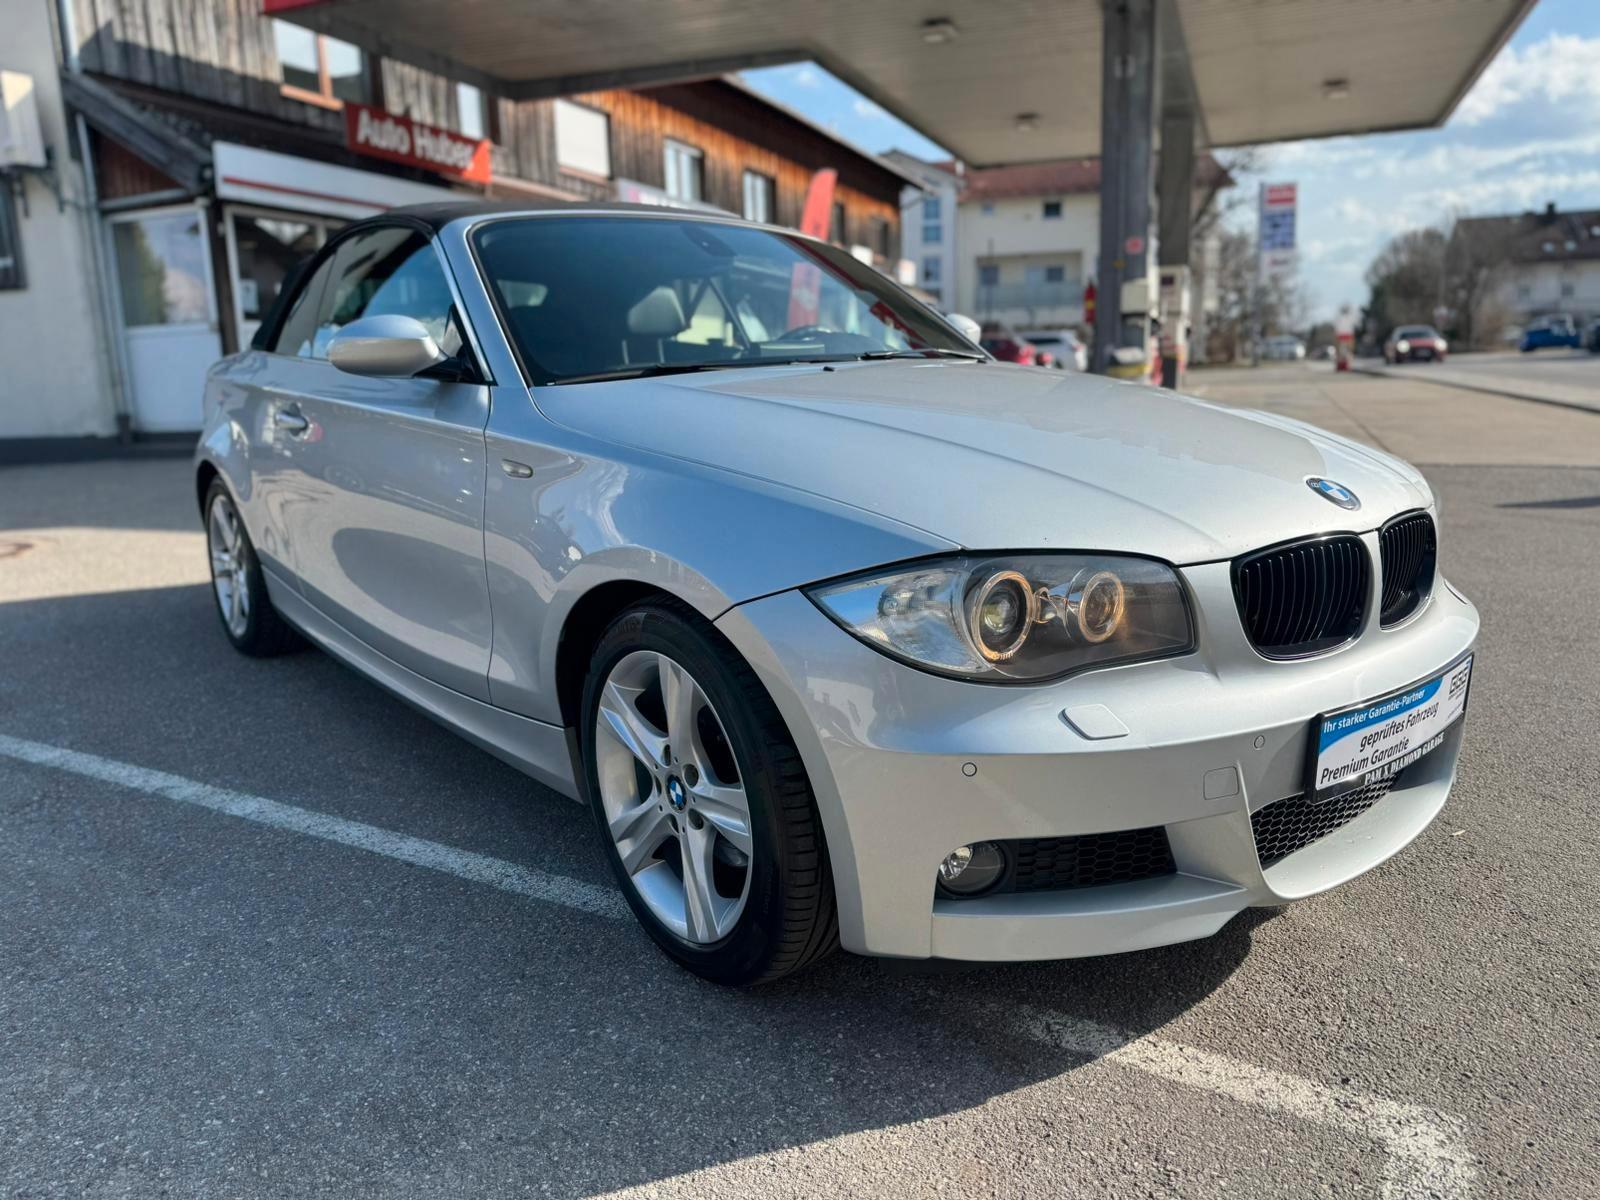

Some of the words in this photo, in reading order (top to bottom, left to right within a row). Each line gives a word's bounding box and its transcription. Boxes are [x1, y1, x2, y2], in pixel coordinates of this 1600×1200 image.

[357, 108, 410, 155] Auto
[412, 123, 475, 169] Huber
[1323, 721, 1336, 733] Ihr
[1338, 712, 1367, 729] starker
[1368, 689, 1425, 718] Garantie-Partner
[1360, 720, 1404, 752] geprüftes
[1405, 702, 1440, 730] Fahrzeug
[1320, 757, 1369, 784] Premium
[1370, 736, 1409, 765] Garantie
[1383, 763, 1390, 777] X
[1390, 748, 1422, 773] DIAMOND
[1422, 731, 1445, 755] GARAGE
